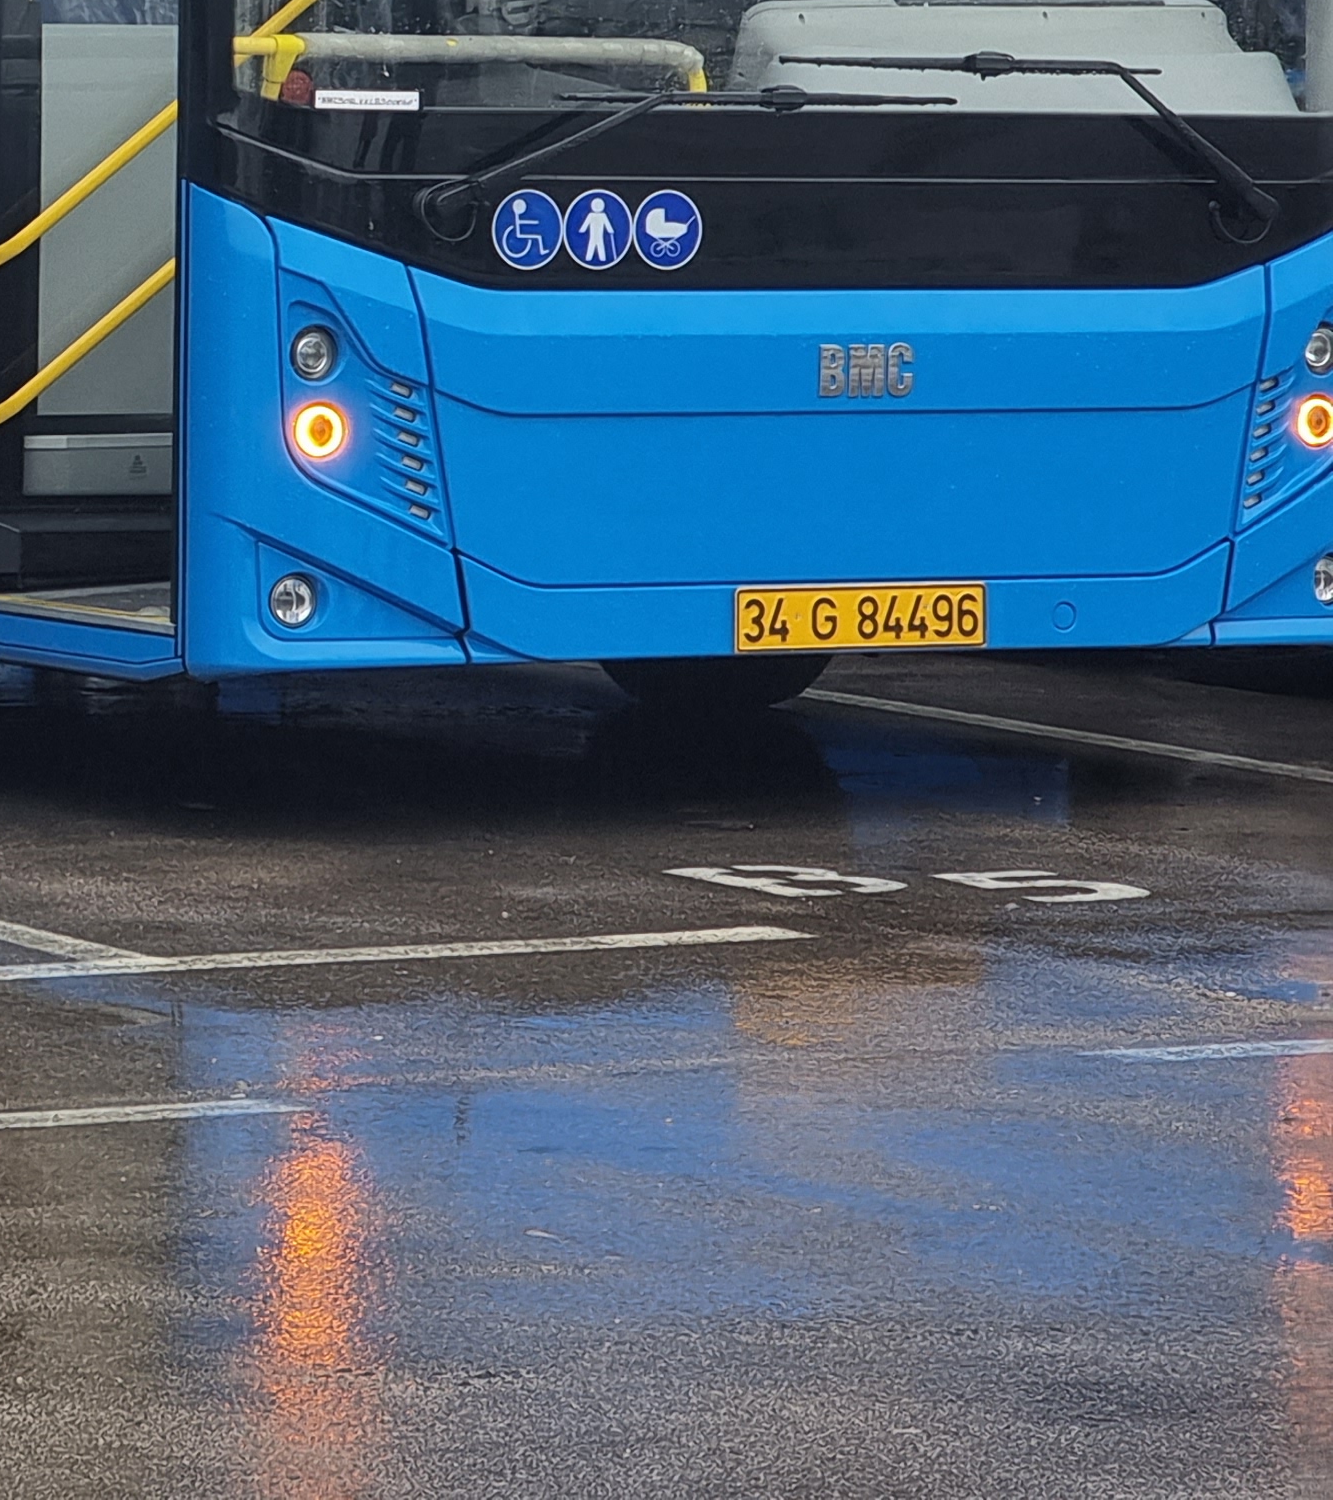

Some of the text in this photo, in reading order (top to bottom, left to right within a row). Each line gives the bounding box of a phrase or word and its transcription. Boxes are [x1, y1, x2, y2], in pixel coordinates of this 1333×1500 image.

[819, 342, 914, 398] BMC
[743, 592, 980, 644] 34 G 84496
